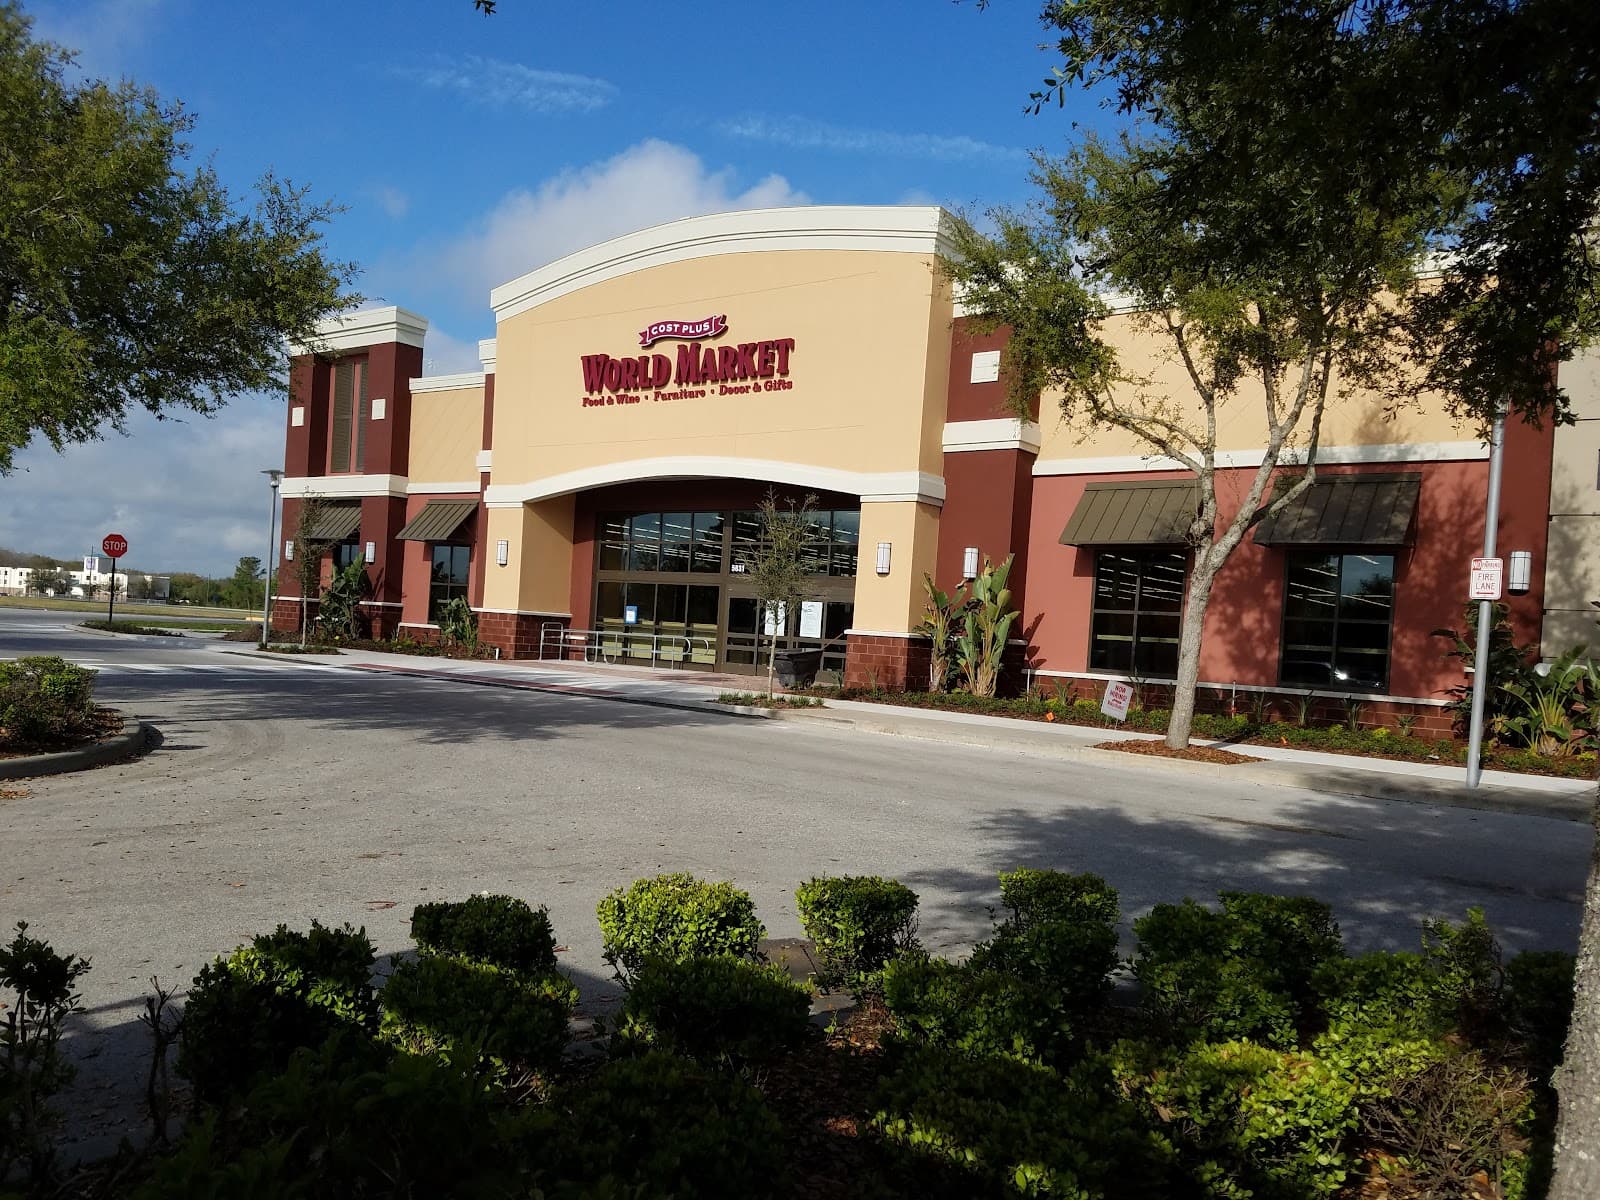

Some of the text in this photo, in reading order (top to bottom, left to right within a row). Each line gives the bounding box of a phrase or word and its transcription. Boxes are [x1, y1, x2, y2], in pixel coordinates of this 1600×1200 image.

[651, 322, 710, 335] COST PLUS
[581, 338, 795, 394] WORLD MARKET
[582, 379, 793, 407] Food & Wine Furniture Decor & Gifts
[103, 540, 127, 551] STOP
[1477, 573, 1495, 581] FIRE
[1475, 582, 1496, 590] LANE
[1114, 684, 1126, 693] NOW
